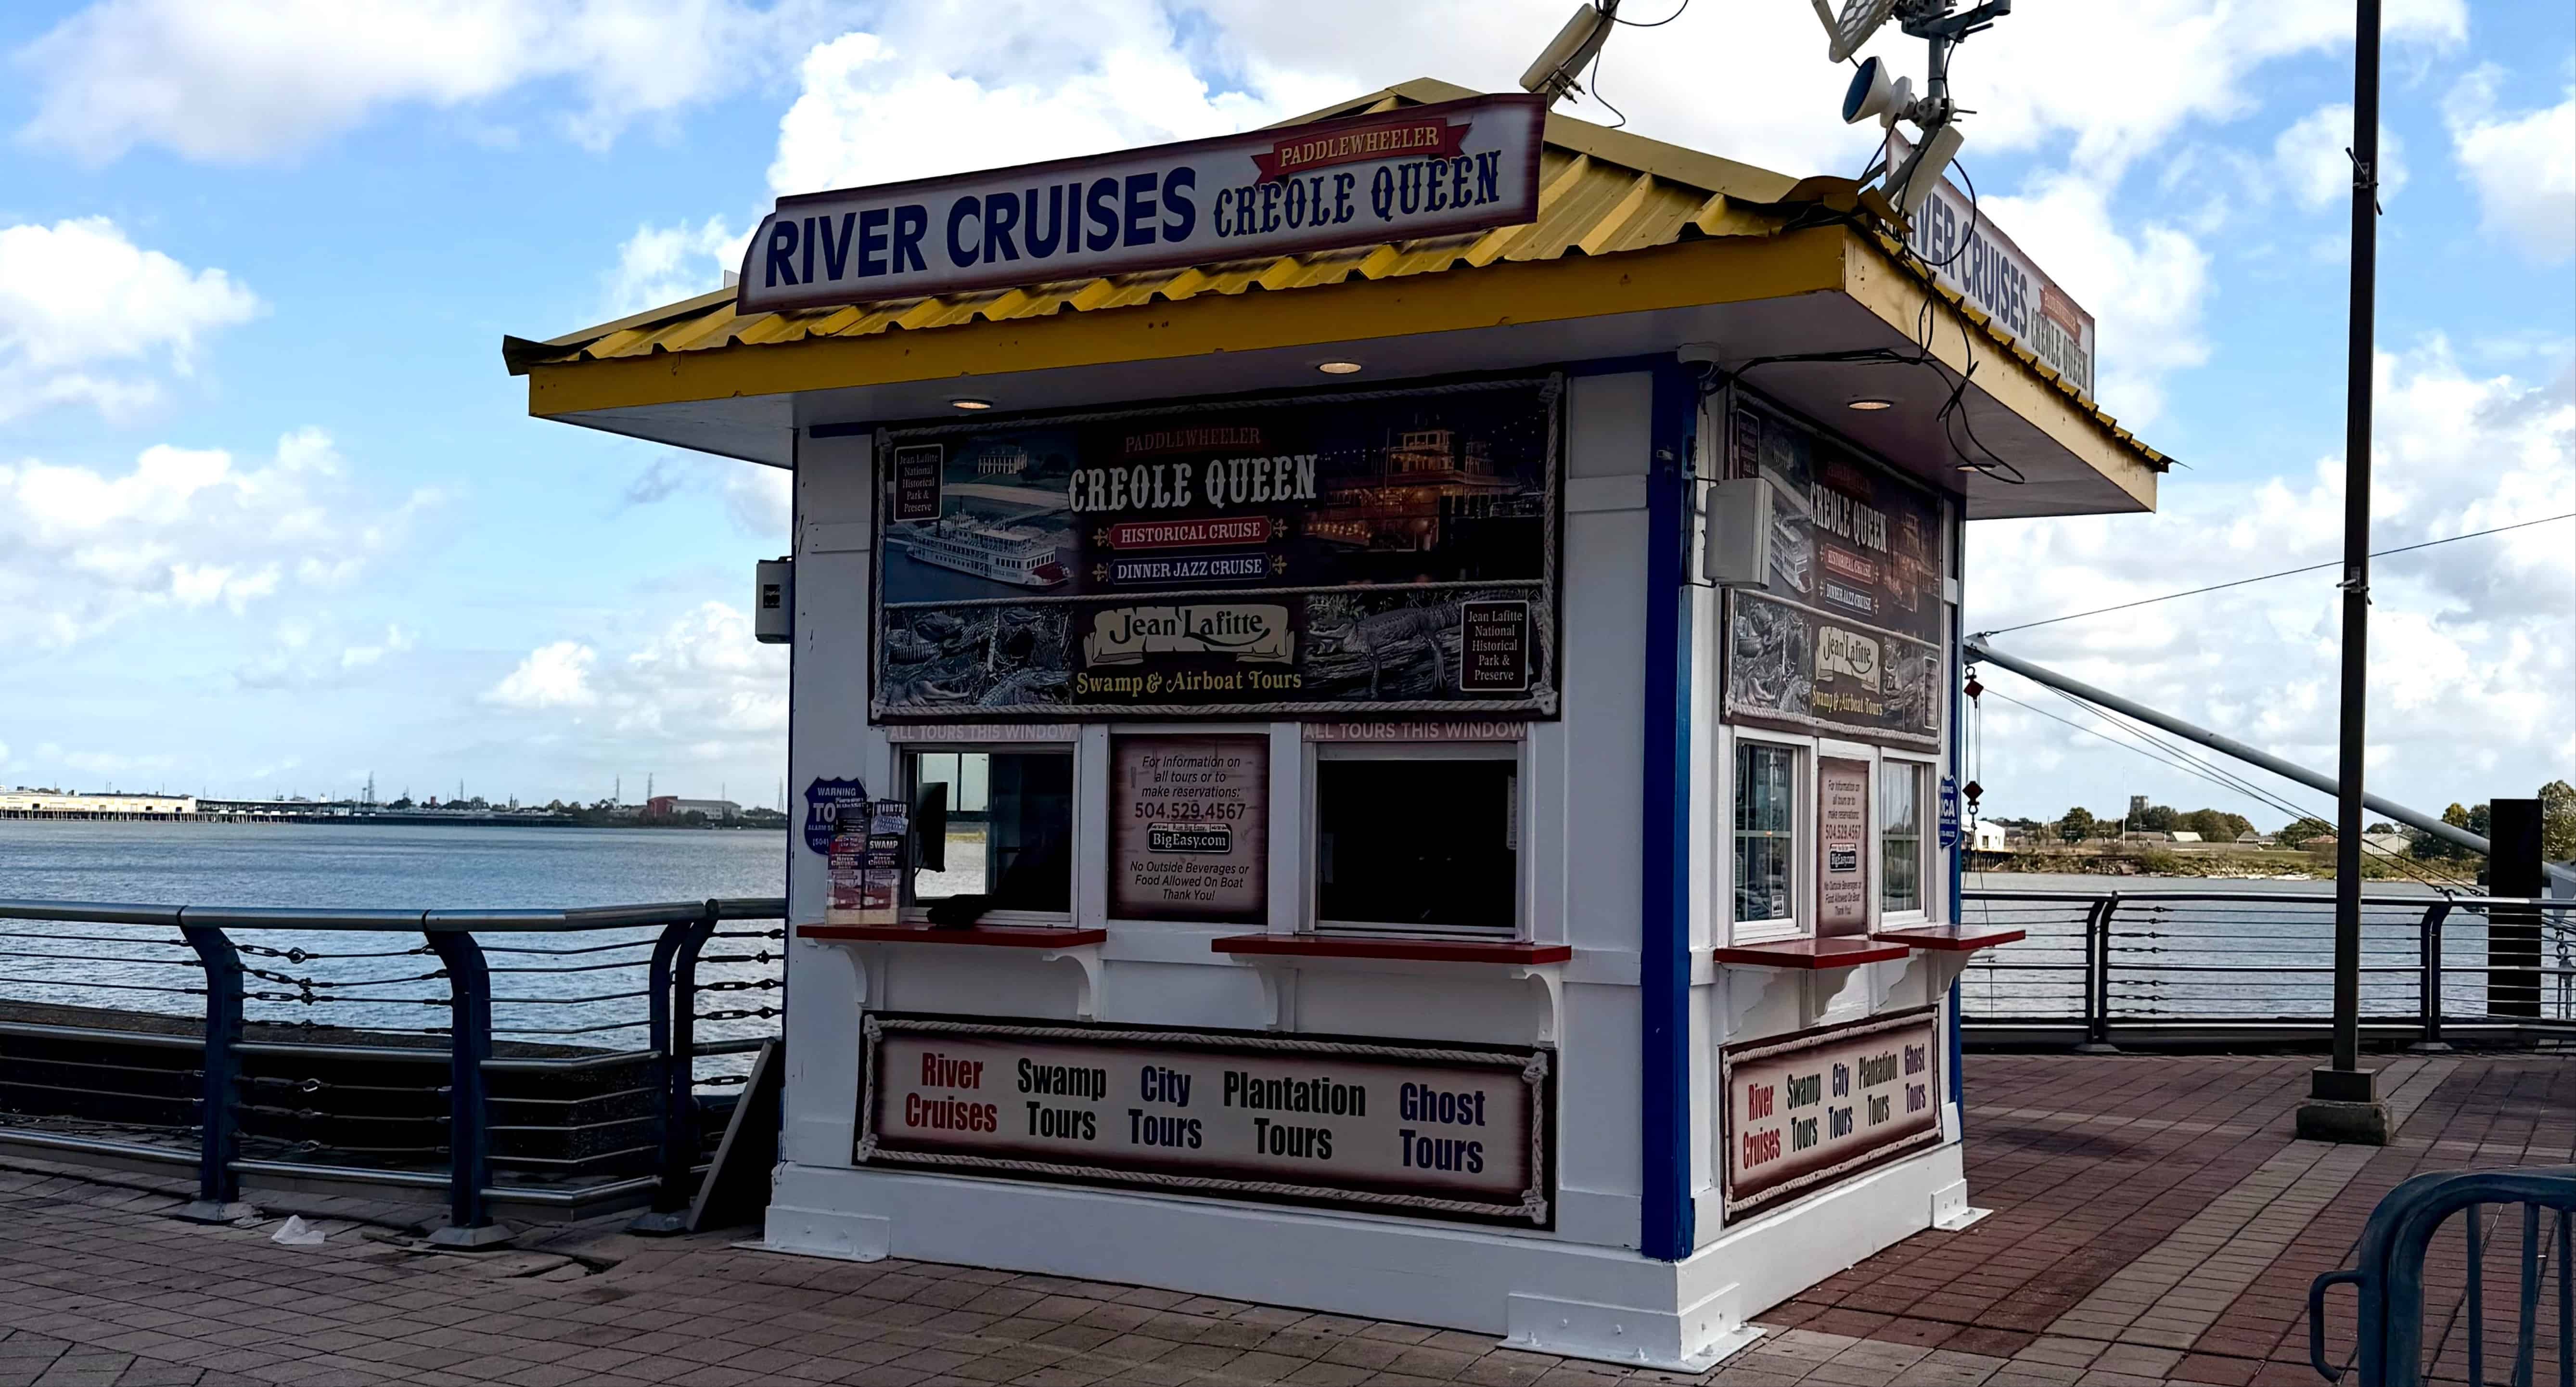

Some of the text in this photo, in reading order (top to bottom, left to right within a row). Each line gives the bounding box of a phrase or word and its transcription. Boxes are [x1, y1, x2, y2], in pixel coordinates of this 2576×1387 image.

[1280, 125, 1439, 168] PADDLEWHEELER
[1213, 150, 1502, 238] CREOLE QUEEN
[765, 167, 1197, 288] RIVER CRUISES
[1961, 221, 2028, 340] CRUISES
[2031, 307, 2061, 369] CREOLE
[2063, 334, 2088, 391] QUEEN
[1125, 427, 1261, 453] PADDLEWHEELER
[907, 489, 922, 501] Park
[1068, 454, 1318, 513] CREOLE QUEEN
[904, 502, 932, 513] Preserve
[1810, 480, 1887, 553] CREOLE QUEEN
[1120, 520, 1261, 544] HISTORICAL CRUISE
[1117, 558, 1262, 579] DINNER JAZZ CRUISE
[1109, 608, 1270, 646] Jean Lafitte
[1468, 610, 1523, 623] Jean Lafitte
[1474, 625, 1515, 638] National
[1472, 639, 1517, 652] Historical
[1478, 654, 1510, 667] Park &
[1823, 632, 1872, 674] Jean Lafitte
[1076, 670, 1302, 697] Swamp & Airboat Tours
[1474, 669, 1514, 681] Preserve
[1812, 685, 1833, 713] Swamp
[1865, 697, 1883, 716] Tours
[889, 723, 1074, 740] ALL TOURS THIS WINDOW
[1302, 722, 1527, 740] ALL TOURS THIS WINDOW
[1142, 756, 1241, 768] For Information on
[1155, 772, 1226, 783] all tours or to
[817, 787, 856, 796] WARNING
[1141, 785, 1240, 798] make reservations:
[813, 802, 836, 823] TO
[1135, 802, 1246, 820] 504.529.4567
[870, 840, 898, 849] SWAMP
[1153, 833, 1226, 849] BigEasy.com
[1130, 860, 1250, 875] No Outside Beverages or
[1135, 874, 1243, 888] Food Allowed On Boat
[1163, 889, 1216, 901] Thank You!
[921, 1052, 984, 1090] River
[1859, 1051, 1897, 1090] Plantation
[1905, 1044, 1924, 1076] Ghost
[1017, 1056, 1107, 1102] Swamp
[1140, 1065, 1192, 1107] City
[1222, 1070, 1367, 1117] Plantation
[1787, 1072, 1820, 1109] Swamp
[1833, 1063, 1849, 1098] City
[904, 1092, 998, 1132] Cruises
[1399, 1081, 1486, 1127] Ghost
[1748, 1083, 1774, 1121] River
[1868, 1093, 1889, 1127] Tours
[1906, 1082, 1925, 1113] Tours
[1026, 1101, 1097, 1141] Tours
[1128, 1107, 1203, 1150] Tours
[1791, 1116, 1817, 1152] Tours
[1829, 1105, 1852, 1140] Tours
[1254, 1117, 1333, 1160] Tours
[1399, 1127, 1484, 1174] Tours
[1743, 1128, 1780, 1169] Cruises
